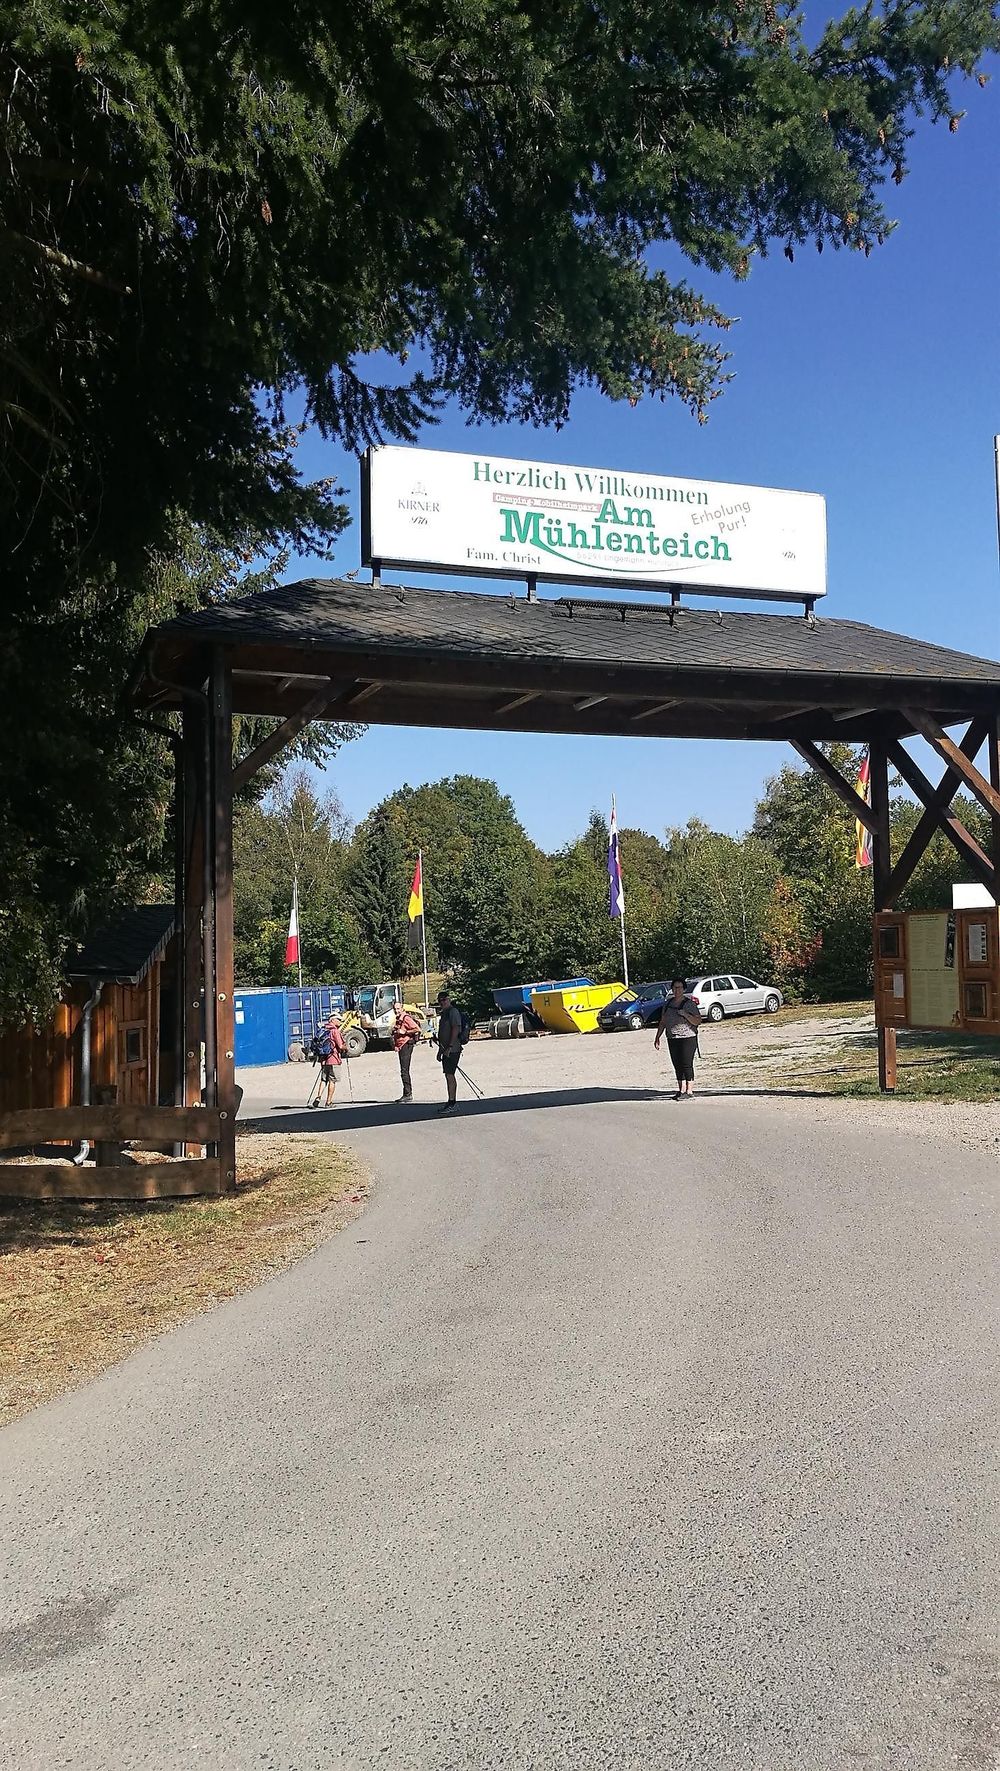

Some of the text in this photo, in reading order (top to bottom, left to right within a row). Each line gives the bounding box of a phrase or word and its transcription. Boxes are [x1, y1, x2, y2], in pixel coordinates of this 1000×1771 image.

[473, 461, 709, 505] Herzlich Willkommen
[398, 499, 440, 512] KIRNER
[595, 498, 655, 528] Am
[691, 501, 751, 526] Erholung
[499, 508, 732, 561] Mühlenteich
[718, 515, 747, 534] Pur!
[467, 547, 541, 565] Fam. Christ
